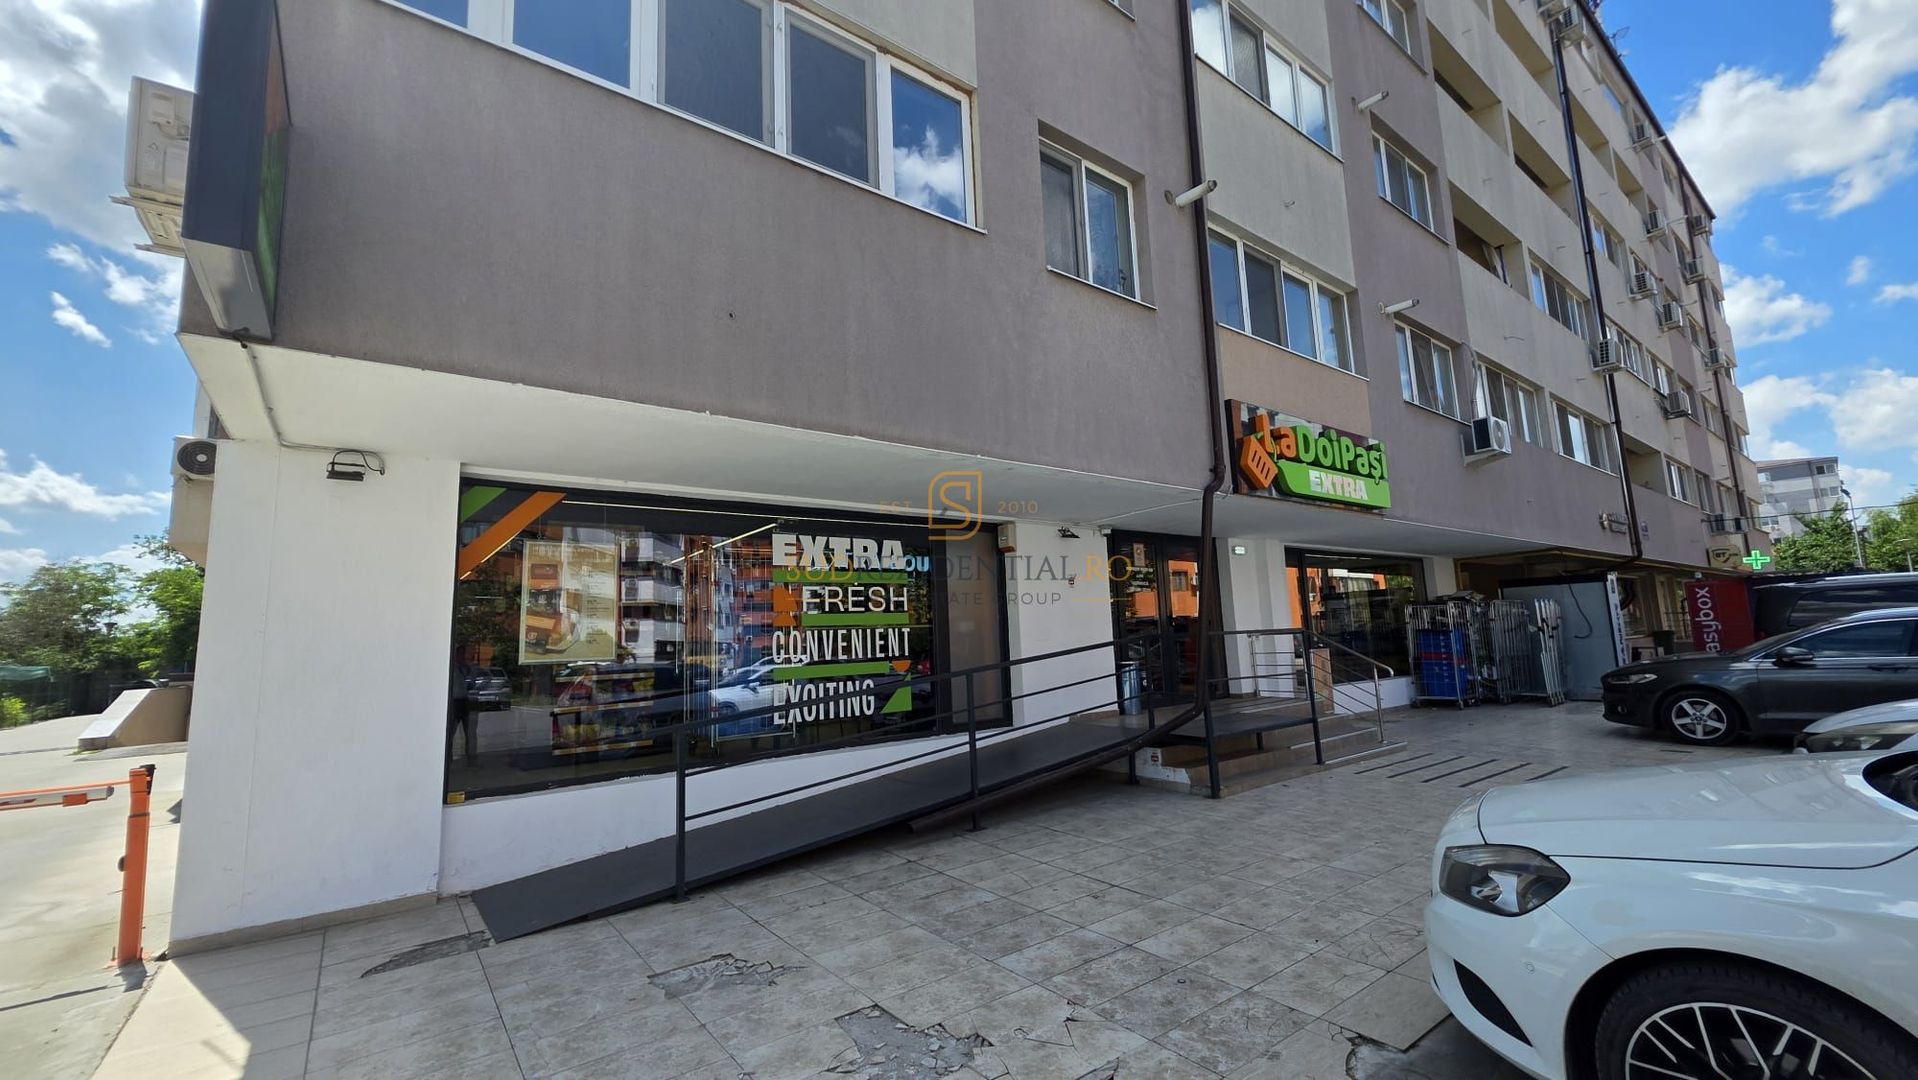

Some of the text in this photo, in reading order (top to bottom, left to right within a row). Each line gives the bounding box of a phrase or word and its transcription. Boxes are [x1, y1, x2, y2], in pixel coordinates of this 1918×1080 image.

[1308, 469, 1368, 500] EXTRA
[772, 533, 905, 570] EXTRA
[802, 586, 909, 612] FRESH
[1695, 586, 1722, 654] asybox
[772, 627, 911, 664] CONVENIENT
[773, 678, 876, 725] EXCITING
